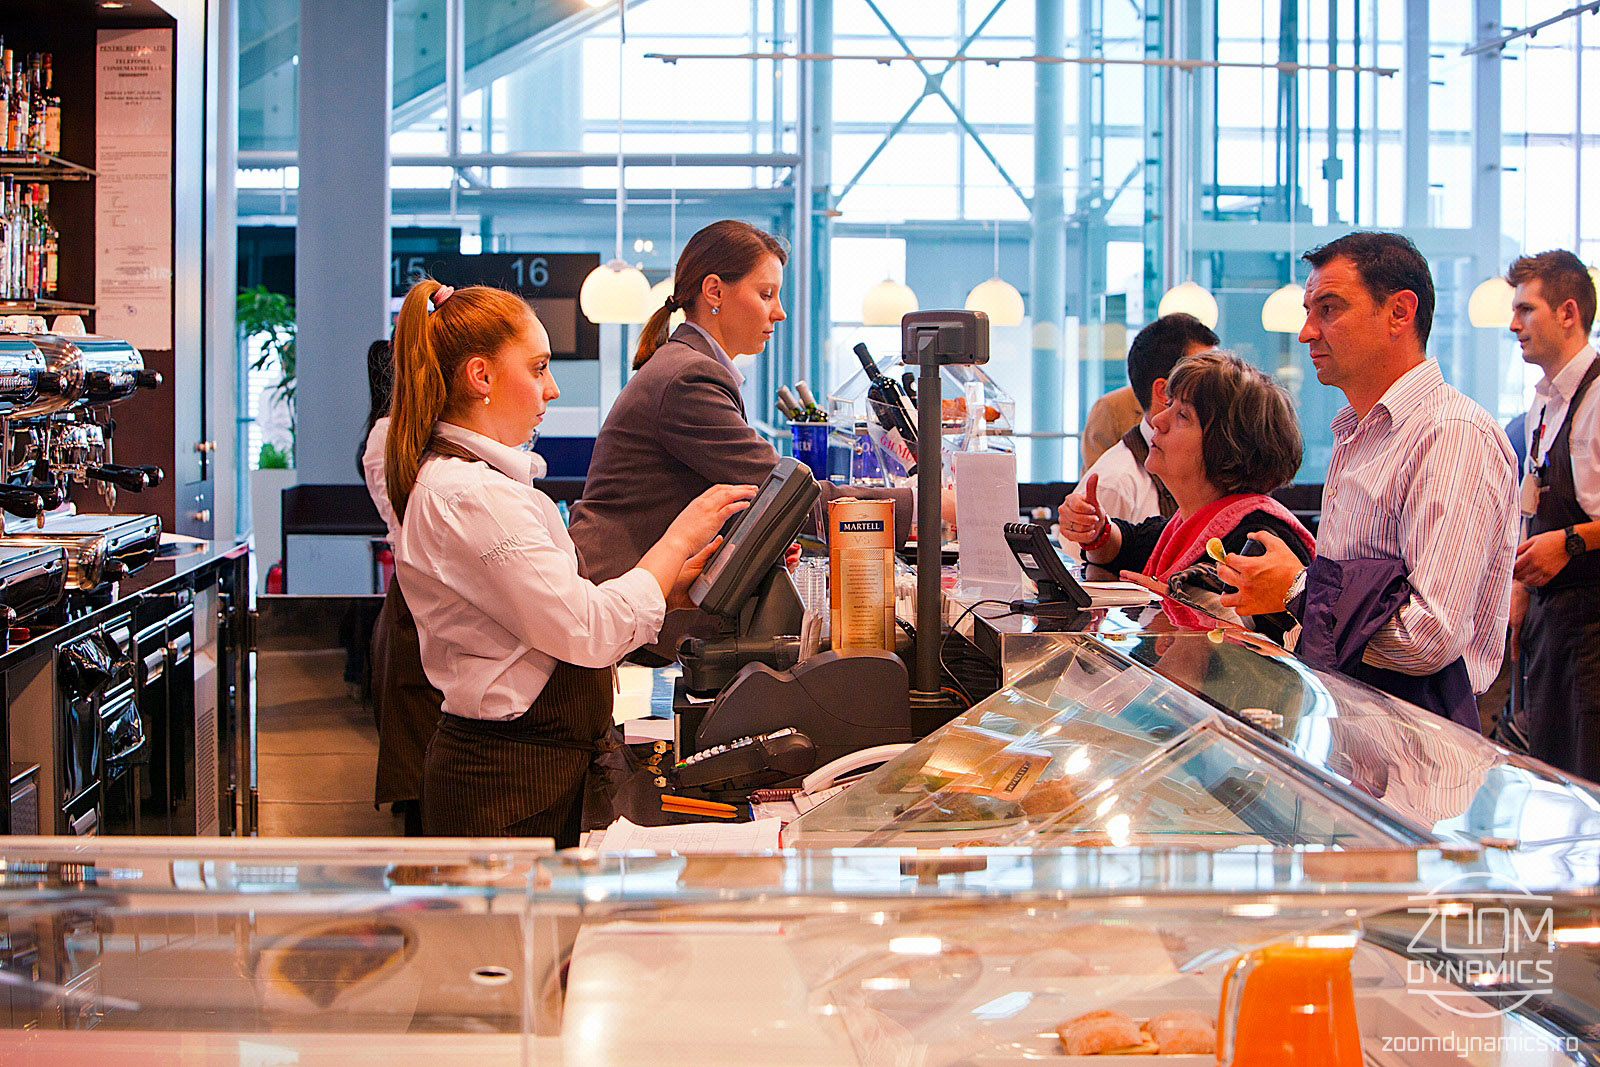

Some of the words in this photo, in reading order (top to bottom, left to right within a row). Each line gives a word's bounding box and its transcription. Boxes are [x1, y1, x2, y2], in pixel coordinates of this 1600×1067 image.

[391, 256, 428, 287] 15
[511, 256, 549, 287] 16
[843, 522, 880, 531] MARTELL
[480, 534, 522, 566] PERONI
